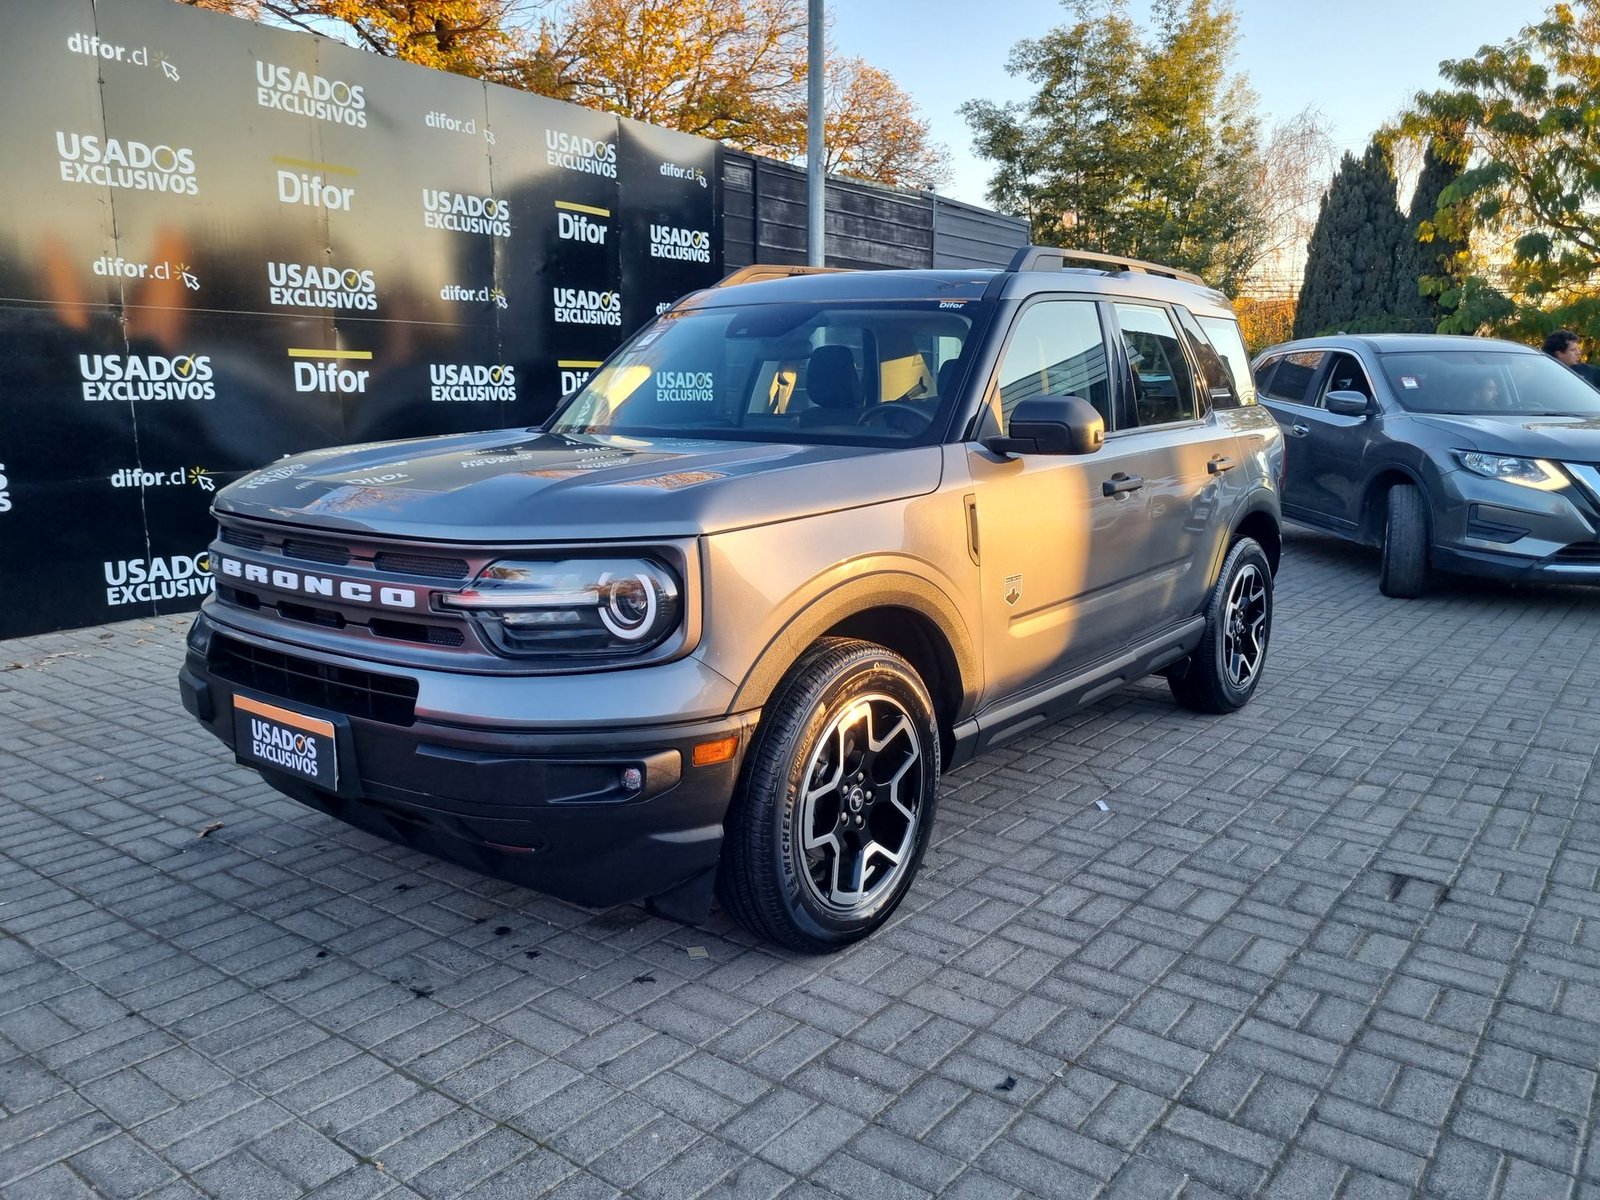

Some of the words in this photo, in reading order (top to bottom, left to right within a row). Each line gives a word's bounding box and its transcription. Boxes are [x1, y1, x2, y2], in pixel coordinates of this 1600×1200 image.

[67, 33, 148, 66] difor.cl
[256, 60, 365, 109] USADOS
[257, 87, 367, 128] EXCLUSIVOS
[425, 111, 475, 135] difor.cl
[56, 131, 196, 174] USADOS
[545, 129, 617, 163] USADOS
[60, 161, 199, 196] EXCLUSIVOS
[547, 150, 617, 179] EXCLUSIVOS
[660, 162, 694, 181] difor.cl
[277, 170, 354, 211] Difor
[423, 189, 509, 220] USADOS
[424, 212, 511, 238] EXCLUSIVOS
[557, 212, 607, 244] Difor
[650, 224, 710, 250] USADOS
[650, 243, 710, 263] EXCLUSIVOS
[93, 257, 170, 280] difor.cl
[268, 262, 375, 293] USADOS
[270, 287, 378, 311] EXCLUSIVOS
[440, 285, 489, 303] difor.cl
[553, 287, 620, 312] USADOS
[554, 307, 621, 326] EXCLUSIVOS
[79, 354, 213, 382] USADOS
[293, 361, 370, 393] Difor
[430, 364, 515, 387] USADOS
[656, 371, 713, 390] USADOS
[82, 380, 216, 401] EXCLUSIVOS
[431, 385, 516, 402] EXCLUSIVOS
[656, 388, 713, 402] EXCLUSIVOS
[111, 467, 186, 488] difor.cl
[104, 552, 213, 586] USADO
[222, 558, 416, 608] BRONCO
[106, 577, 215, 606] EXCLUSIV
[251, 718, 317, 760] USADOS
[252, 739, 318, 777] EXCLUSIVOS
[782, 785, 795, 875] MICHELIN
